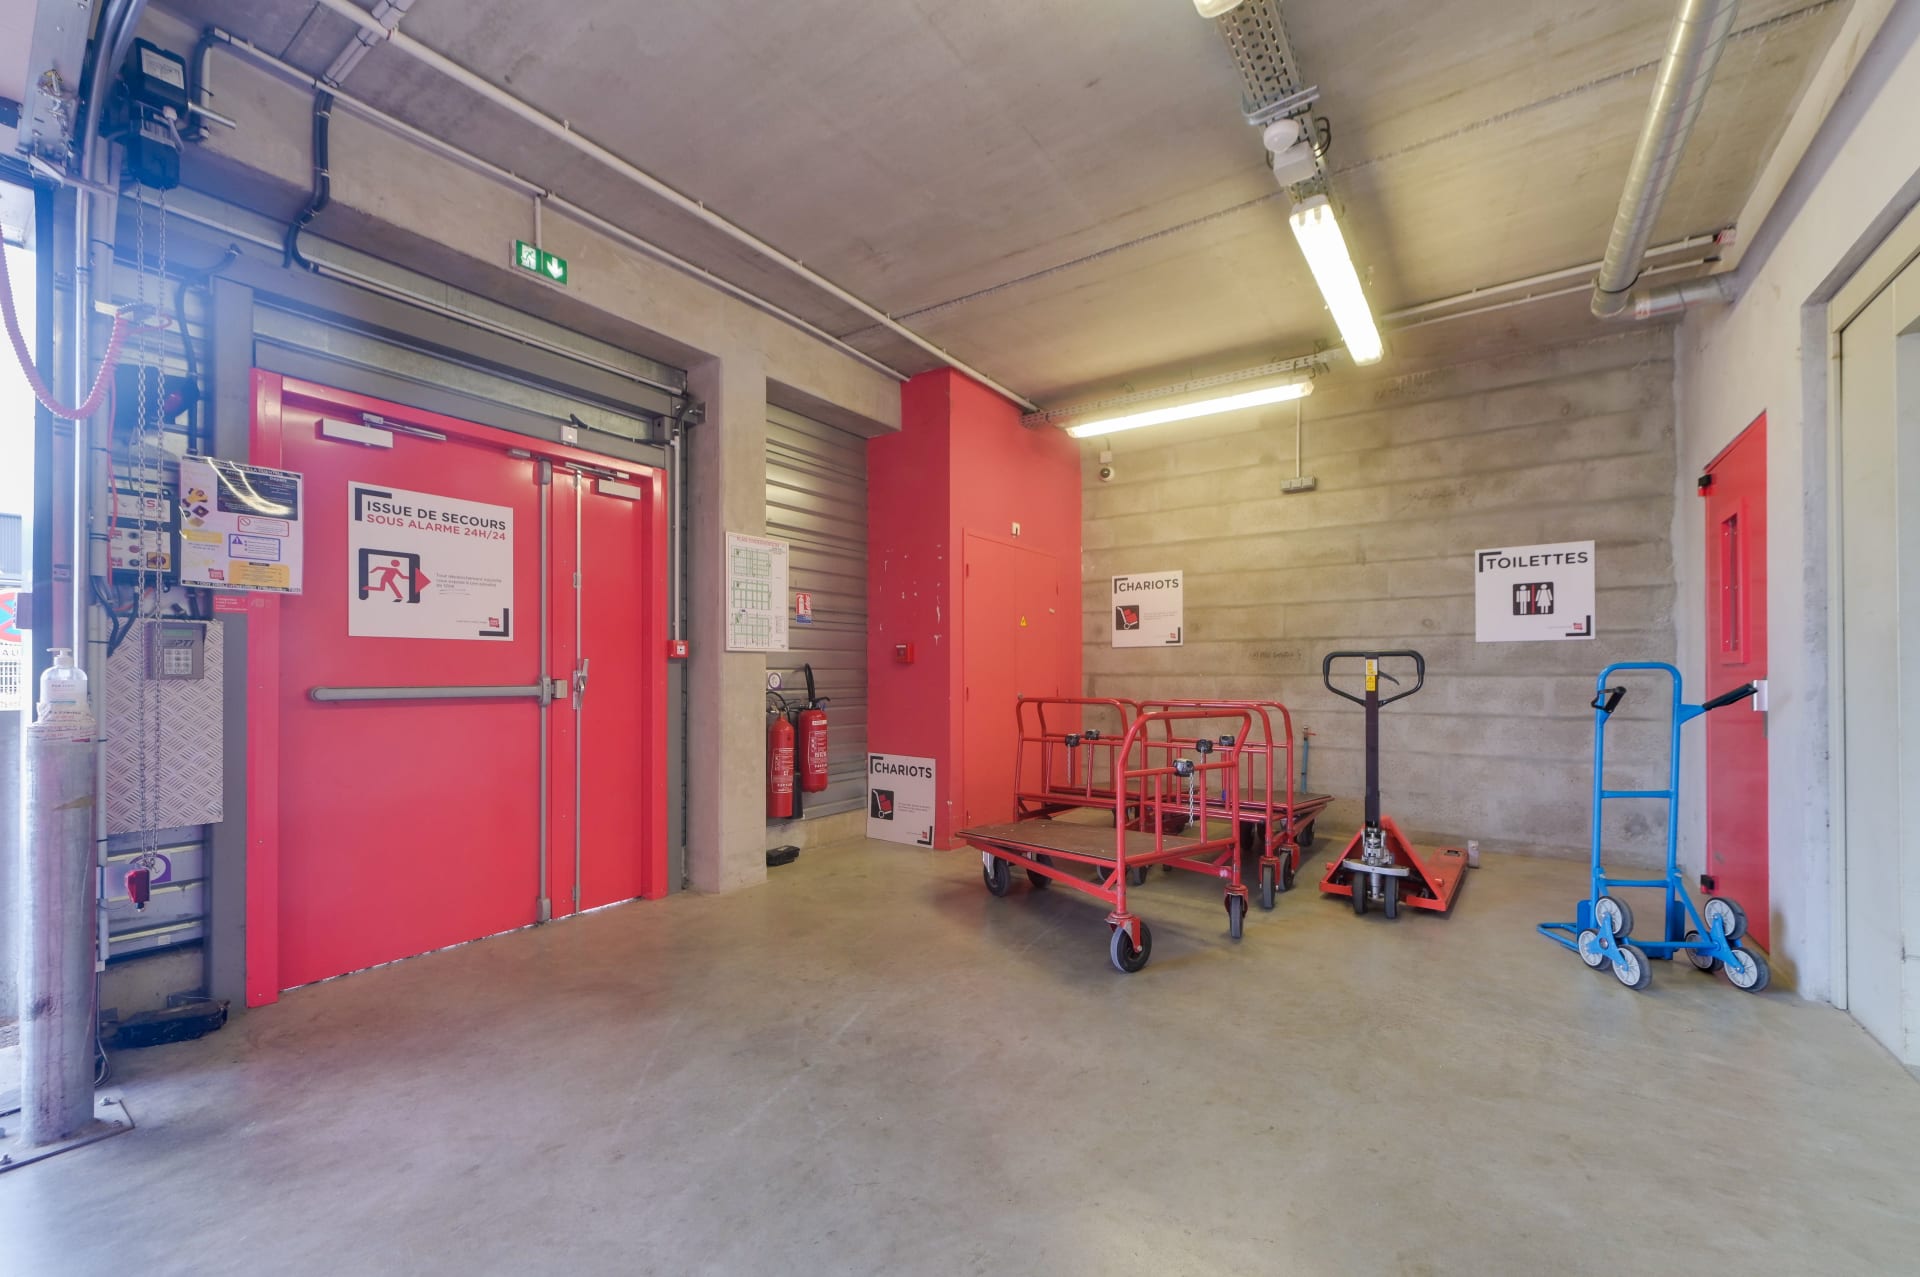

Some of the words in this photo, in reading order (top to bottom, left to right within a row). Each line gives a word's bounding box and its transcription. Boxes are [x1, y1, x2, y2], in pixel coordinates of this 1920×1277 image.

[367, 500, 412, 517] ISSUE
[418, 508, 437, 521] DE
[442, 512, 506, 531] SECOURS
[367, 513, 404, 527] SOUS
[408, 519, 460, 535] ALARME
[464, 527, 506, 541] 24H/24
[1486, 551, 1589, 570] TOILETTES
[1118, 578, 1180, 592] CHARIOTS
[874, 762, 933, 779] CHARIOTS
